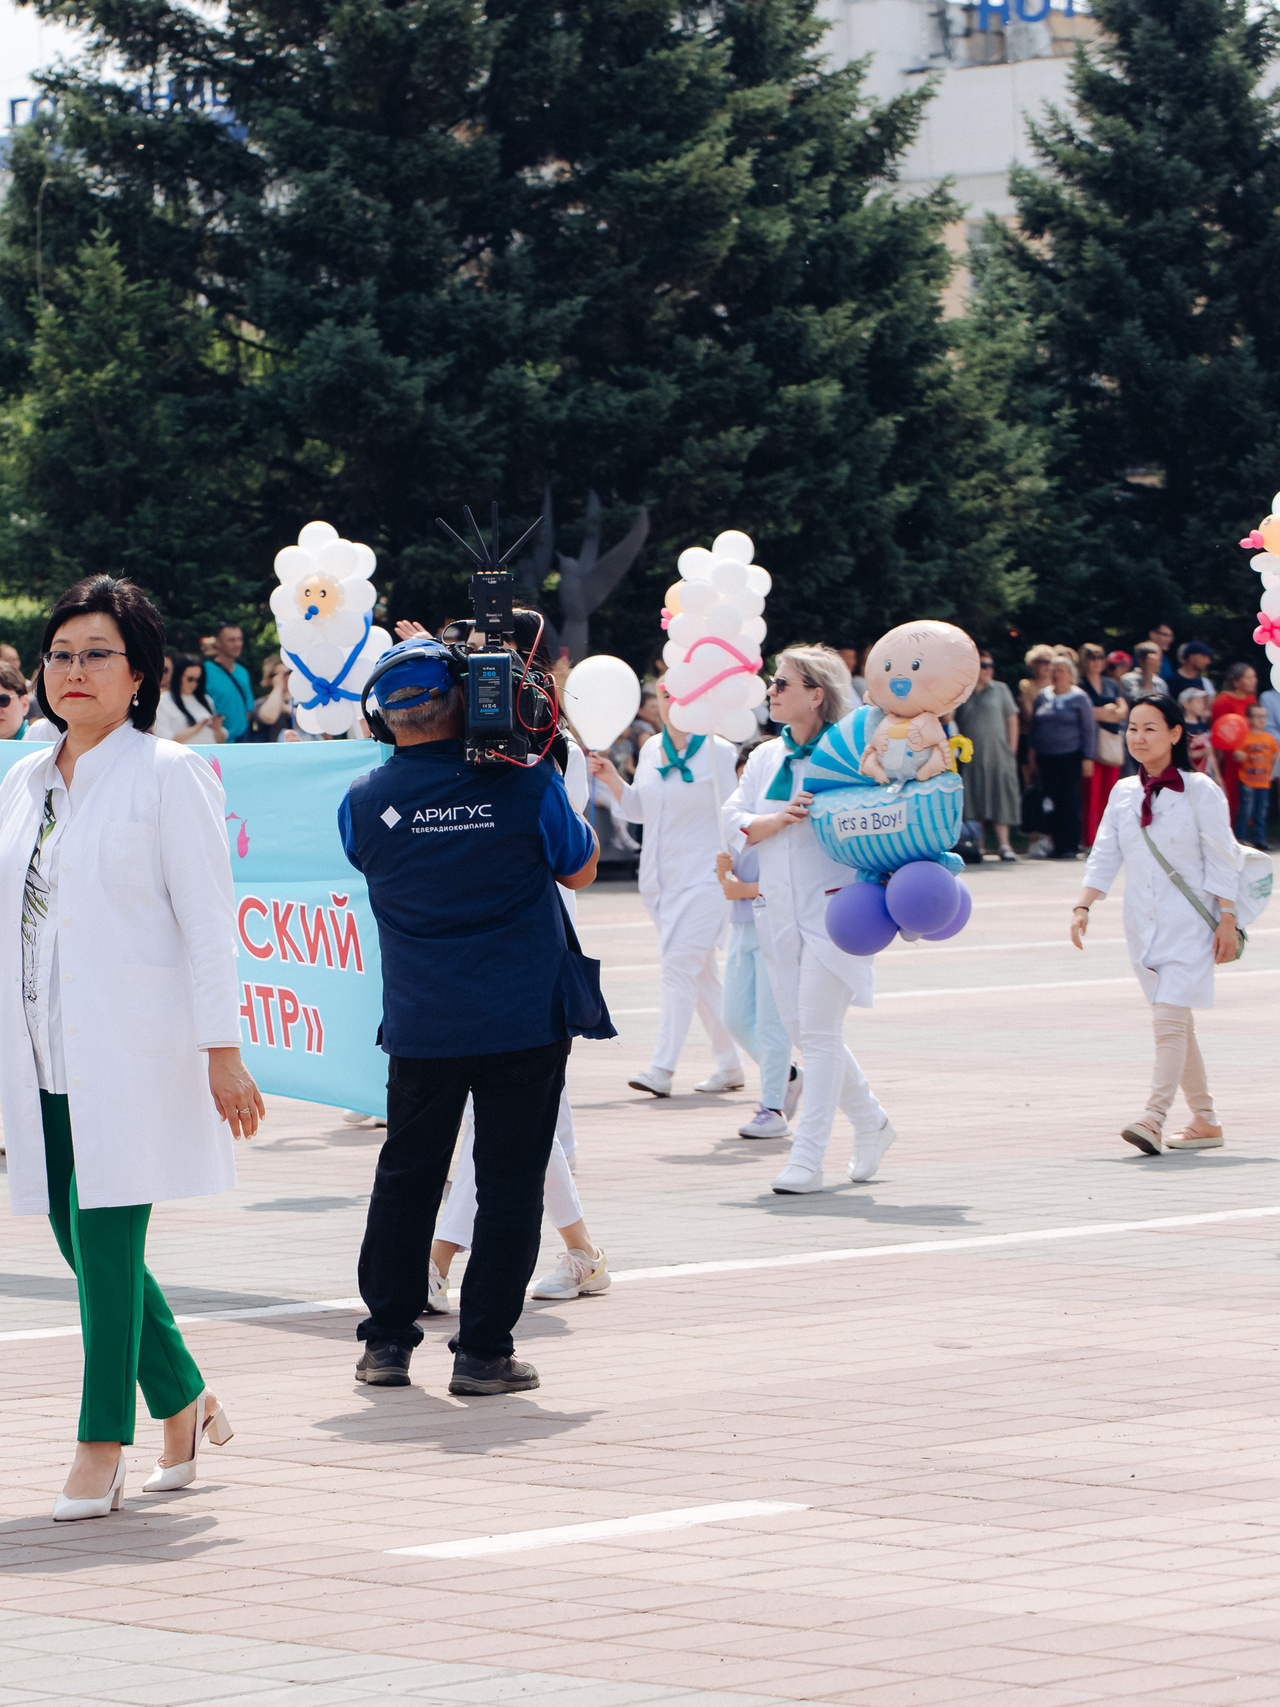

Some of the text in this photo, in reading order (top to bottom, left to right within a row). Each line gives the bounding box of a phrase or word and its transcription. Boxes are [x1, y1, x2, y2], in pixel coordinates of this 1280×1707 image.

[412, 804, 493, 823] АРИГУС
[837, 810, 903, 832] it's a Boy!
[410, 821, 495, 834] ТЕЛЕРАДИОКОМПАНИЯ
